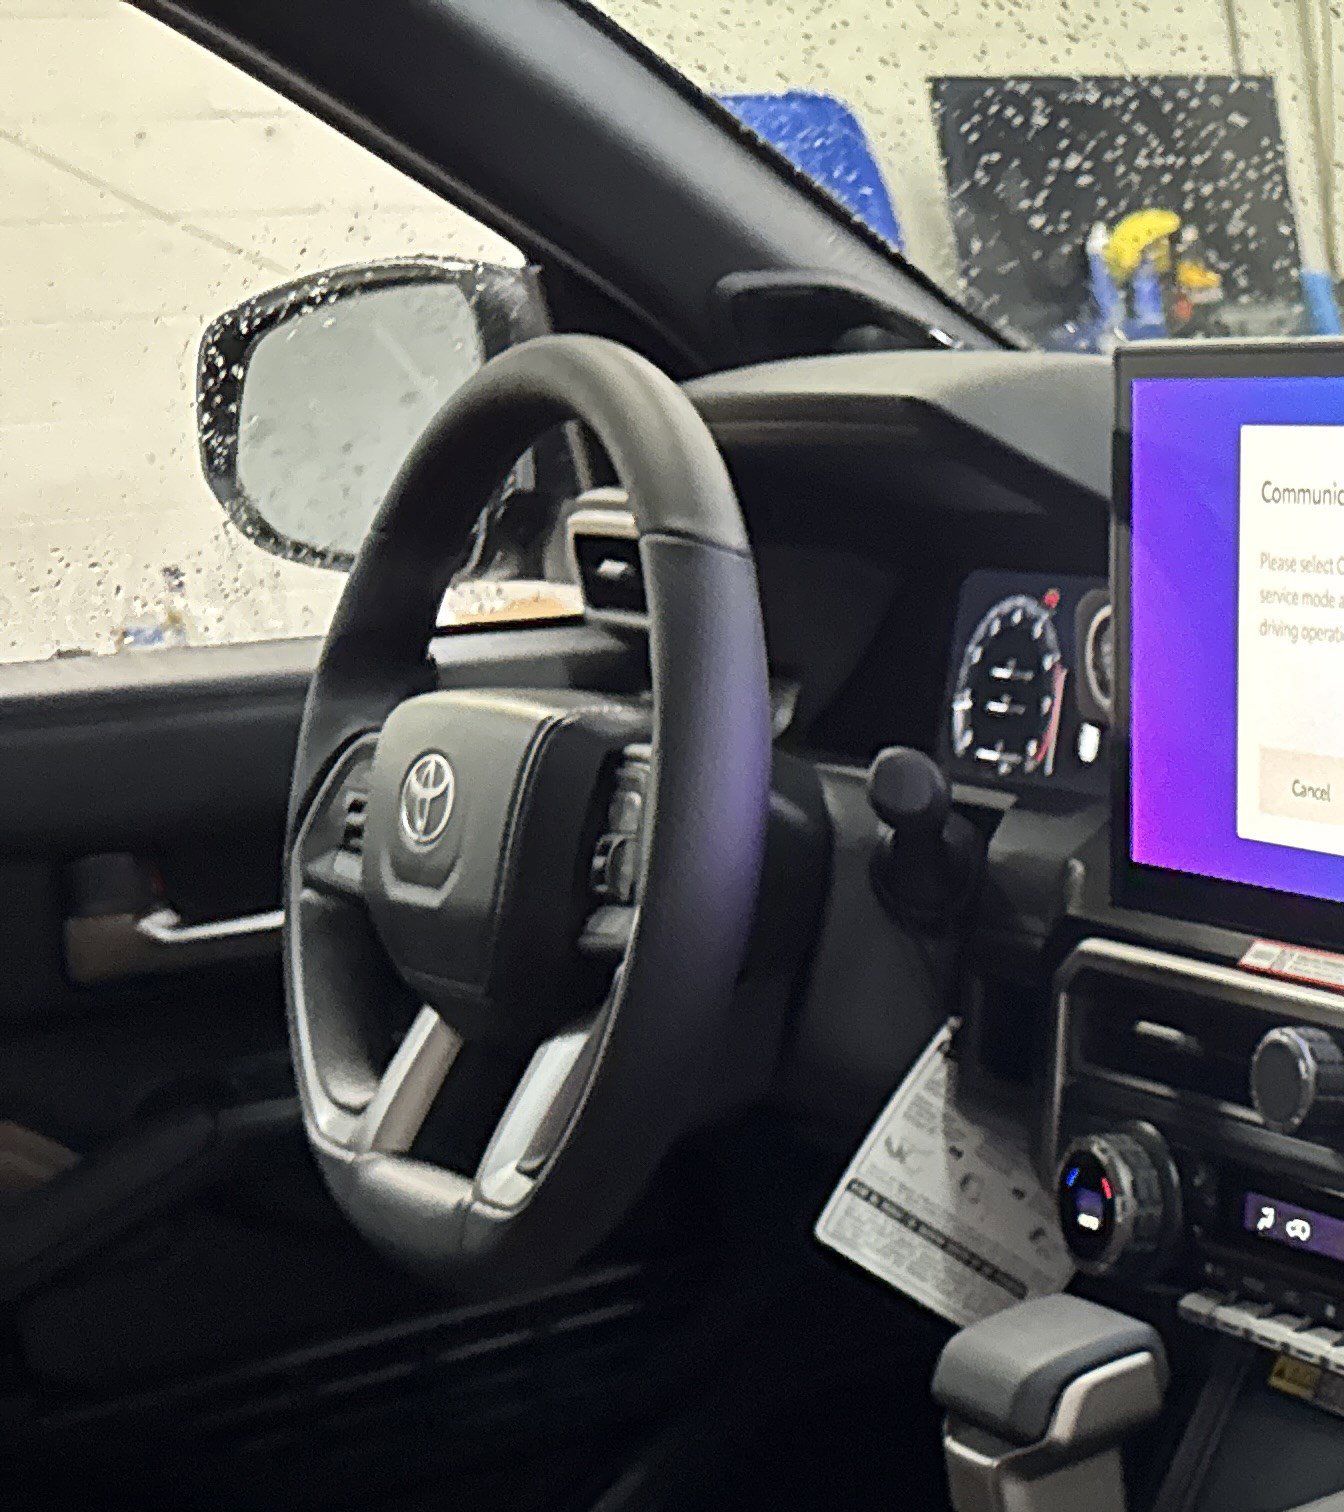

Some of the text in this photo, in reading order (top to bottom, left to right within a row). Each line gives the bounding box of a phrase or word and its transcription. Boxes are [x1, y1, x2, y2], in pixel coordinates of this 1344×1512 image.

[1259, 552, 1297, 573] Please
[1299, 555, 1334, 576] select
[1259, 587, 1299, 606] service
[1302, 590, 1336, 608] mode
[1258, 619, 1299, 644] driving
[1291, 778, 1331, 802] Cancel
